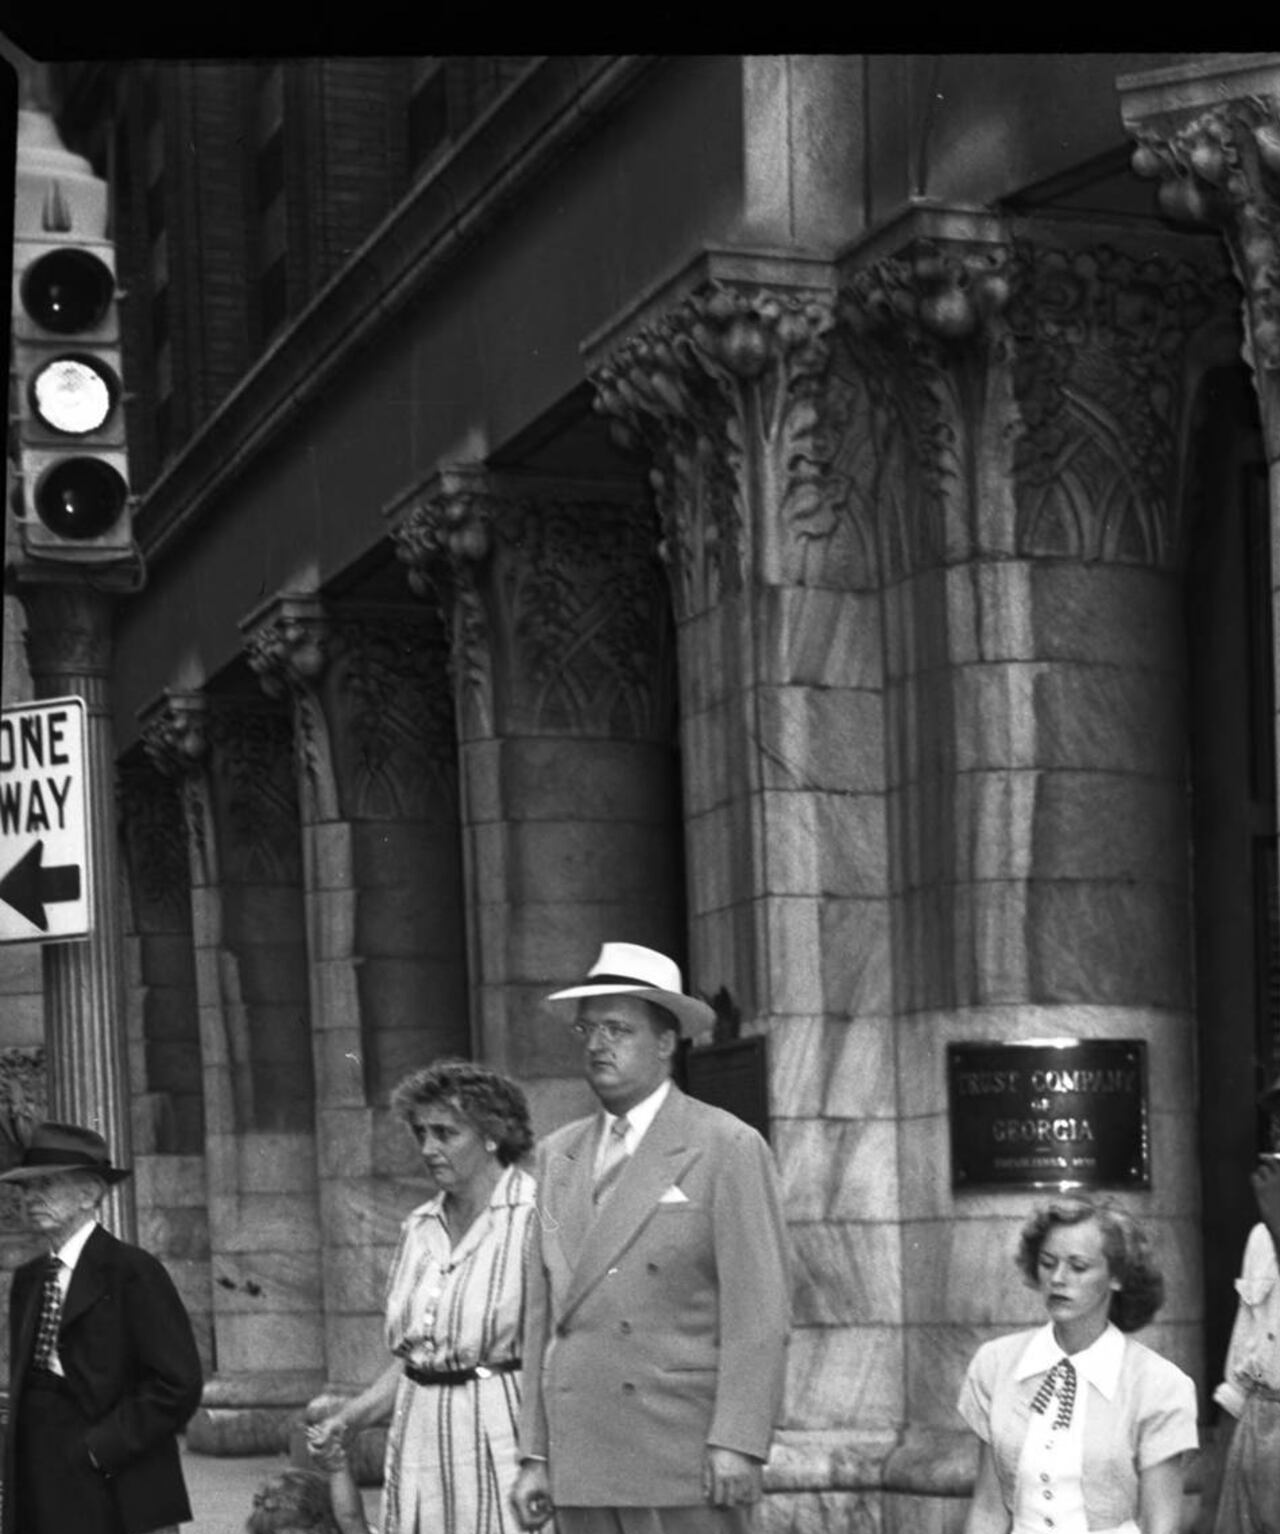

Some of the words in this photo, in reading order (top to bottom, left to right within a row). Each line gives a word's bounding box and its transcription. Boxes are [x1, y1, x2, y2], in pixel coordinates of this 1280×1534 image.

[0, 711, 69, 772] ONE
[0, 775, 71, 835] WAY
[1031, 1070, 1137, 1092] COMPANY
[992, 1118, 1094, 1141] GEORGIA
